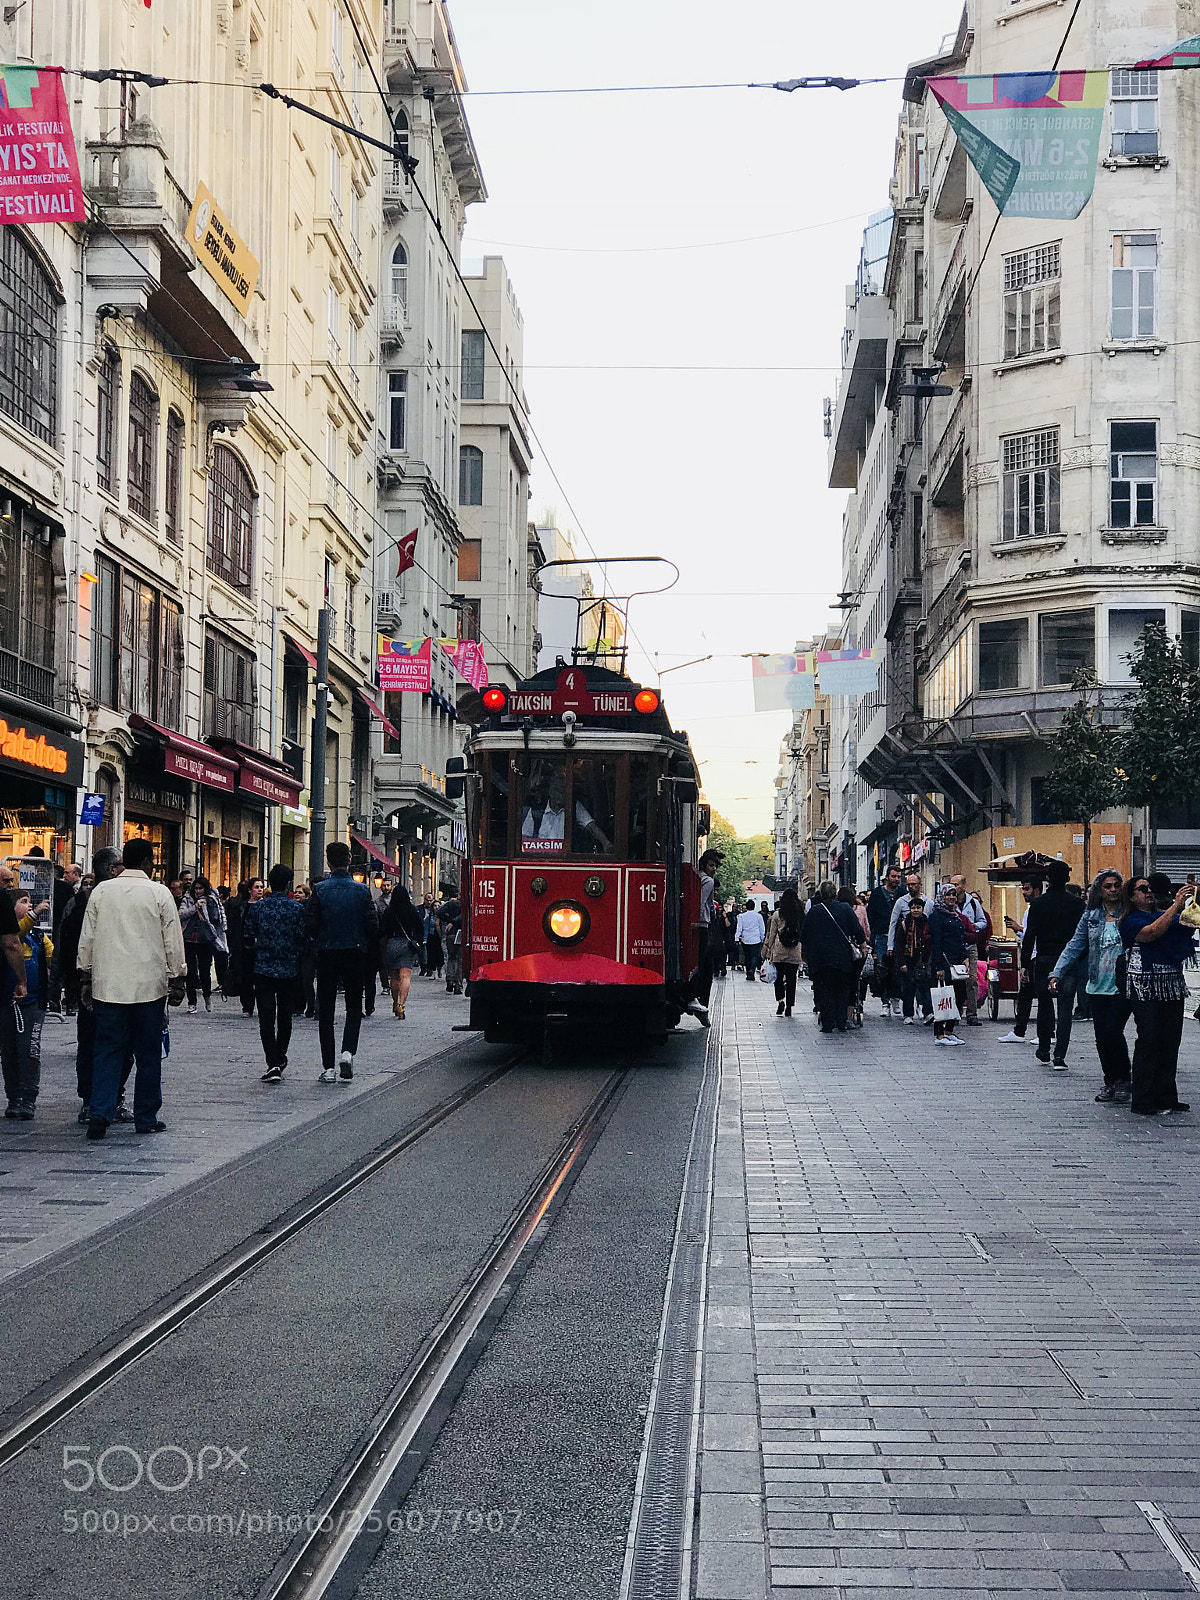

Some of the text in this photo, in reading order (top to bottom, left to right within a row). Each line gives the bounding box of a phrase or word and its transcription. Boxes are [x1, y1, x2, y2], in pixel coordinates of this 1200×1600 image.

[0, 141, 70, 171] YIS'TA
[379, 663, 428, 675] 2-6 MAYIS'TA
[565, 672, 575, 690] 4
[509, 692, 632, 712] TAKSİM TÜNEL
[523, 840, 563, 850] TAKSİM
[20, 870, 35, 882] POLİS
[478, 880, 496, 898] 115
[639, 884, 657, 902] 115
[937, 996, 953, 1011] H&M
